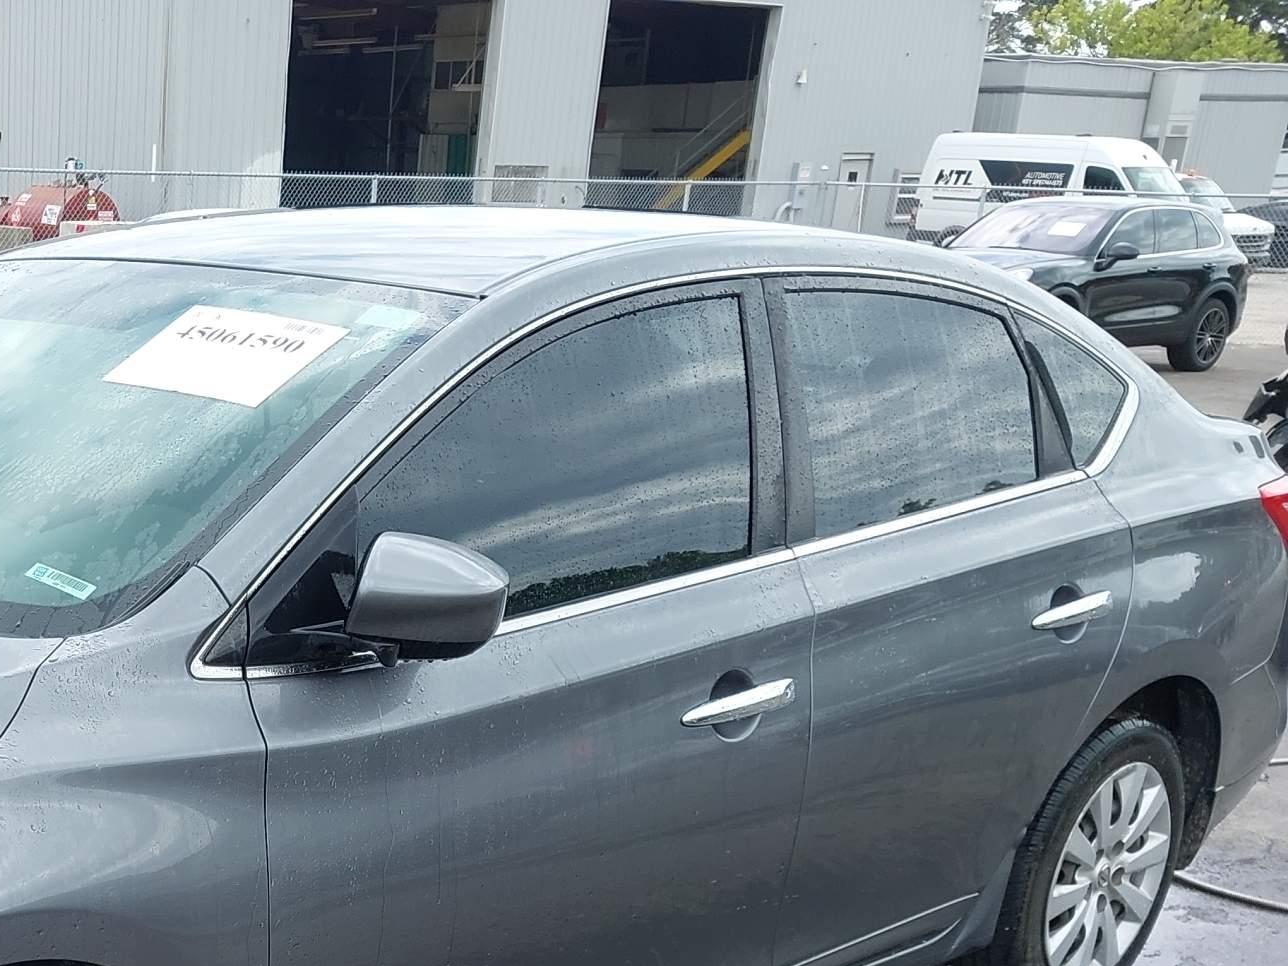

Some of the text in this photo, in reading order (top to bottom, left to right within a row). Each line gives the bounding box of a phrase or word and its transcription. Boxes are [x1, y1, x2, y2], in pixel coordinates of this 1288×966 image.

[934, 169, 973, 186] HTL
[1024, 172, 1066, 180] AUTOMOTIVE
[176, 325, 306, 353] 45061590
